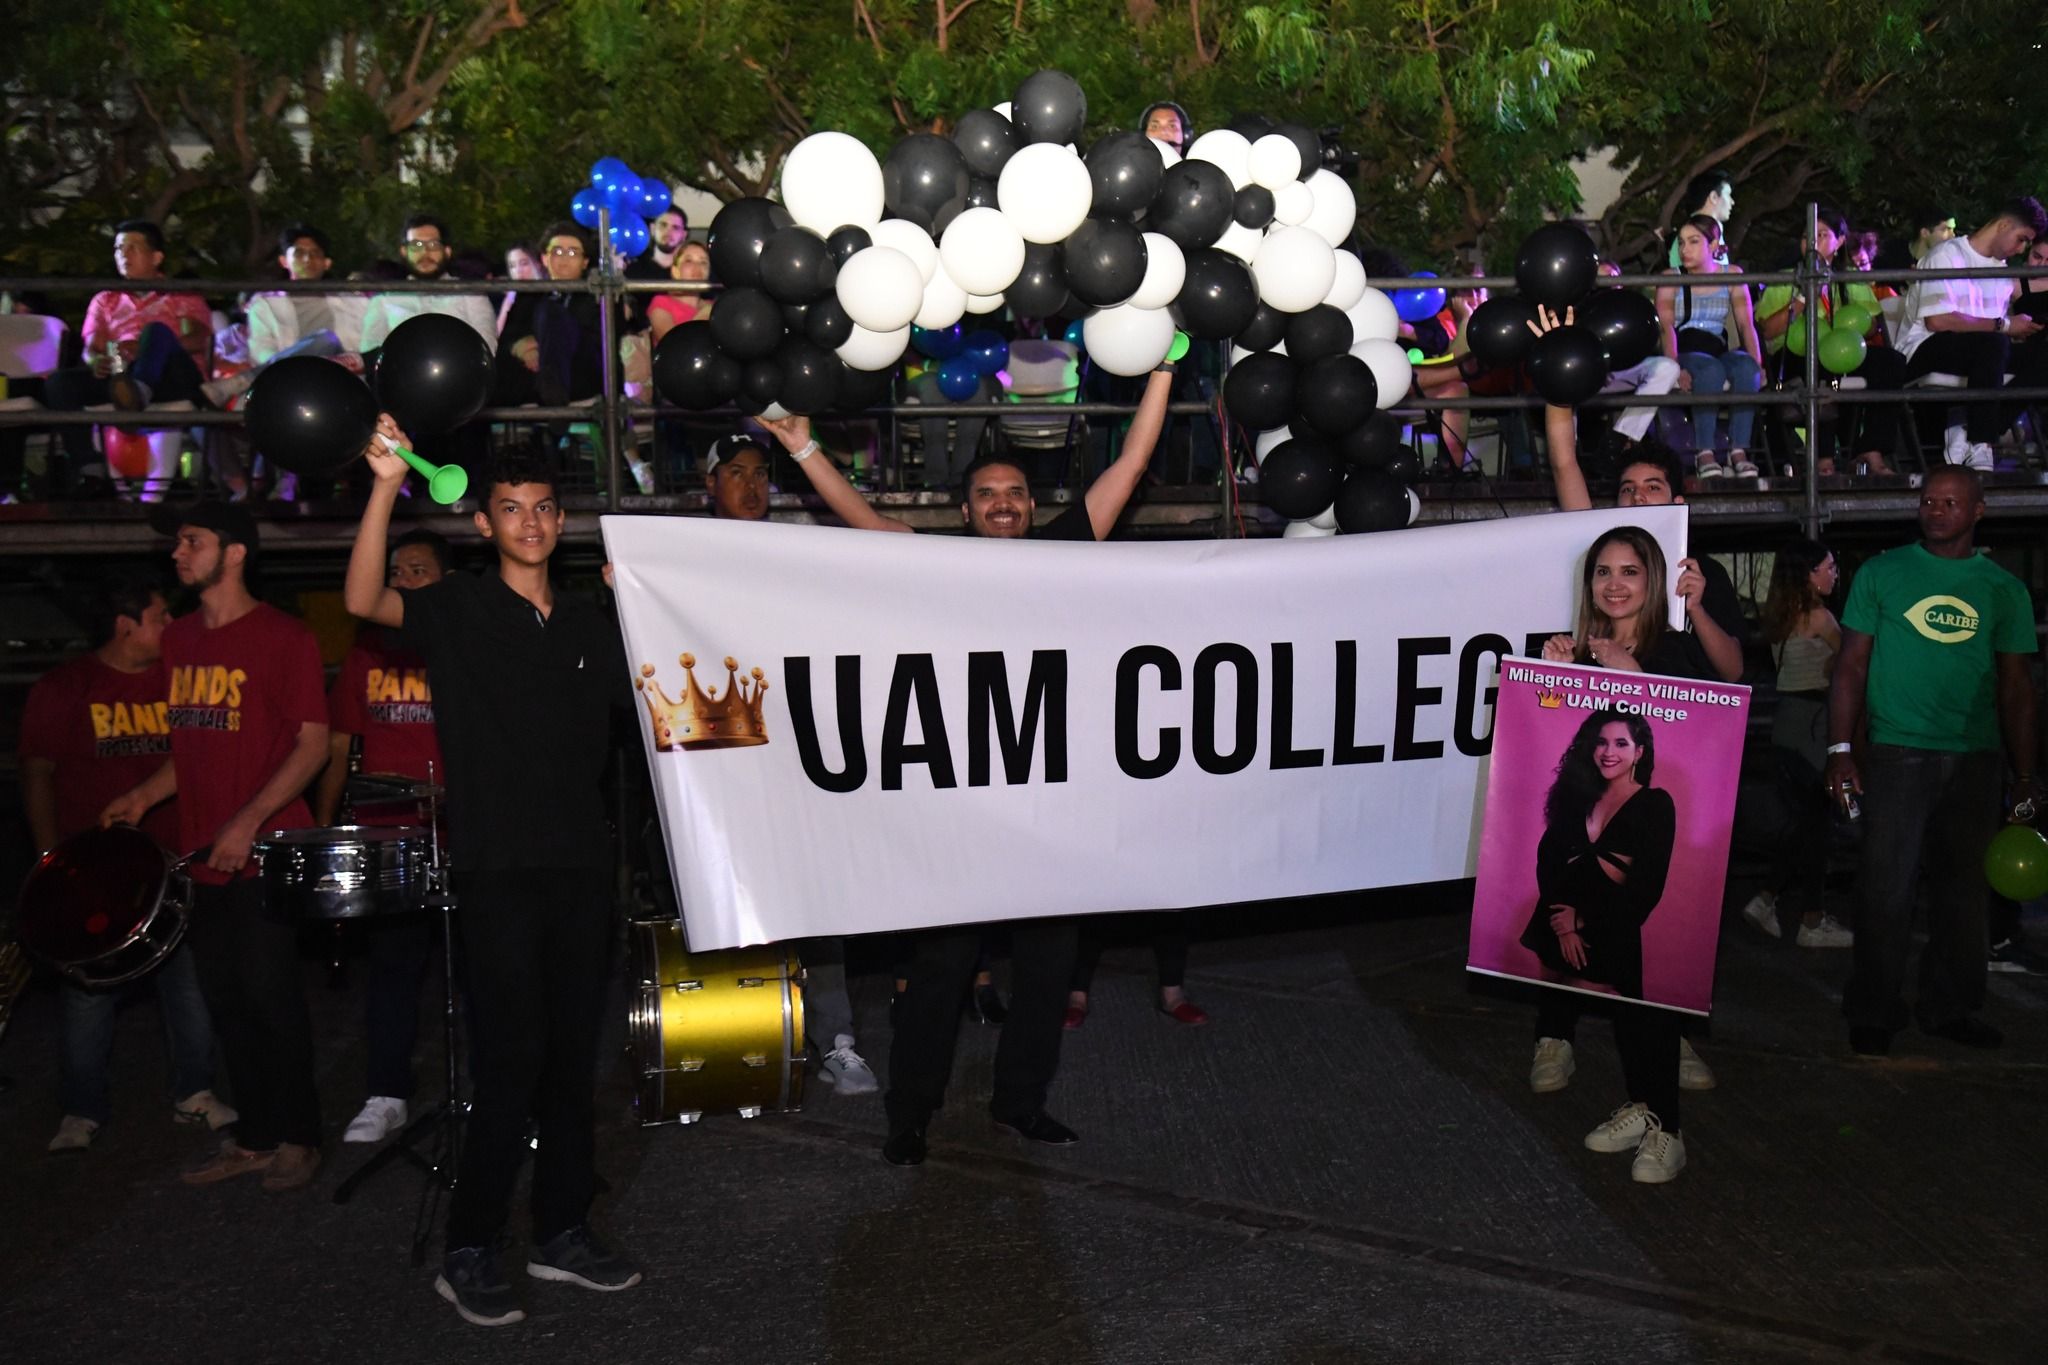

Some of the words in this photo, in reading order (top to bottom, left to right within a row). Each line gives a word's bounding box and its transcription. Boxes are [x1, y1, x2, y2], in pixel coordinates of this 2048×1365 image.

[1925, 610, 1980, 630] CARIBE
[366, 666, 433, 702] BAN
[1507, 667, 1583, 691] Milagros
[1588, 673, 1643, 697] López
[1648, 683, 1741, 707] Villalobos
[783, 649, 1068, 793] UAM
[1114, 632, 1573, 780] COLLEG
[1566, 693, 1610, 712] UAM
[1615, 699, 1688, 722] College
